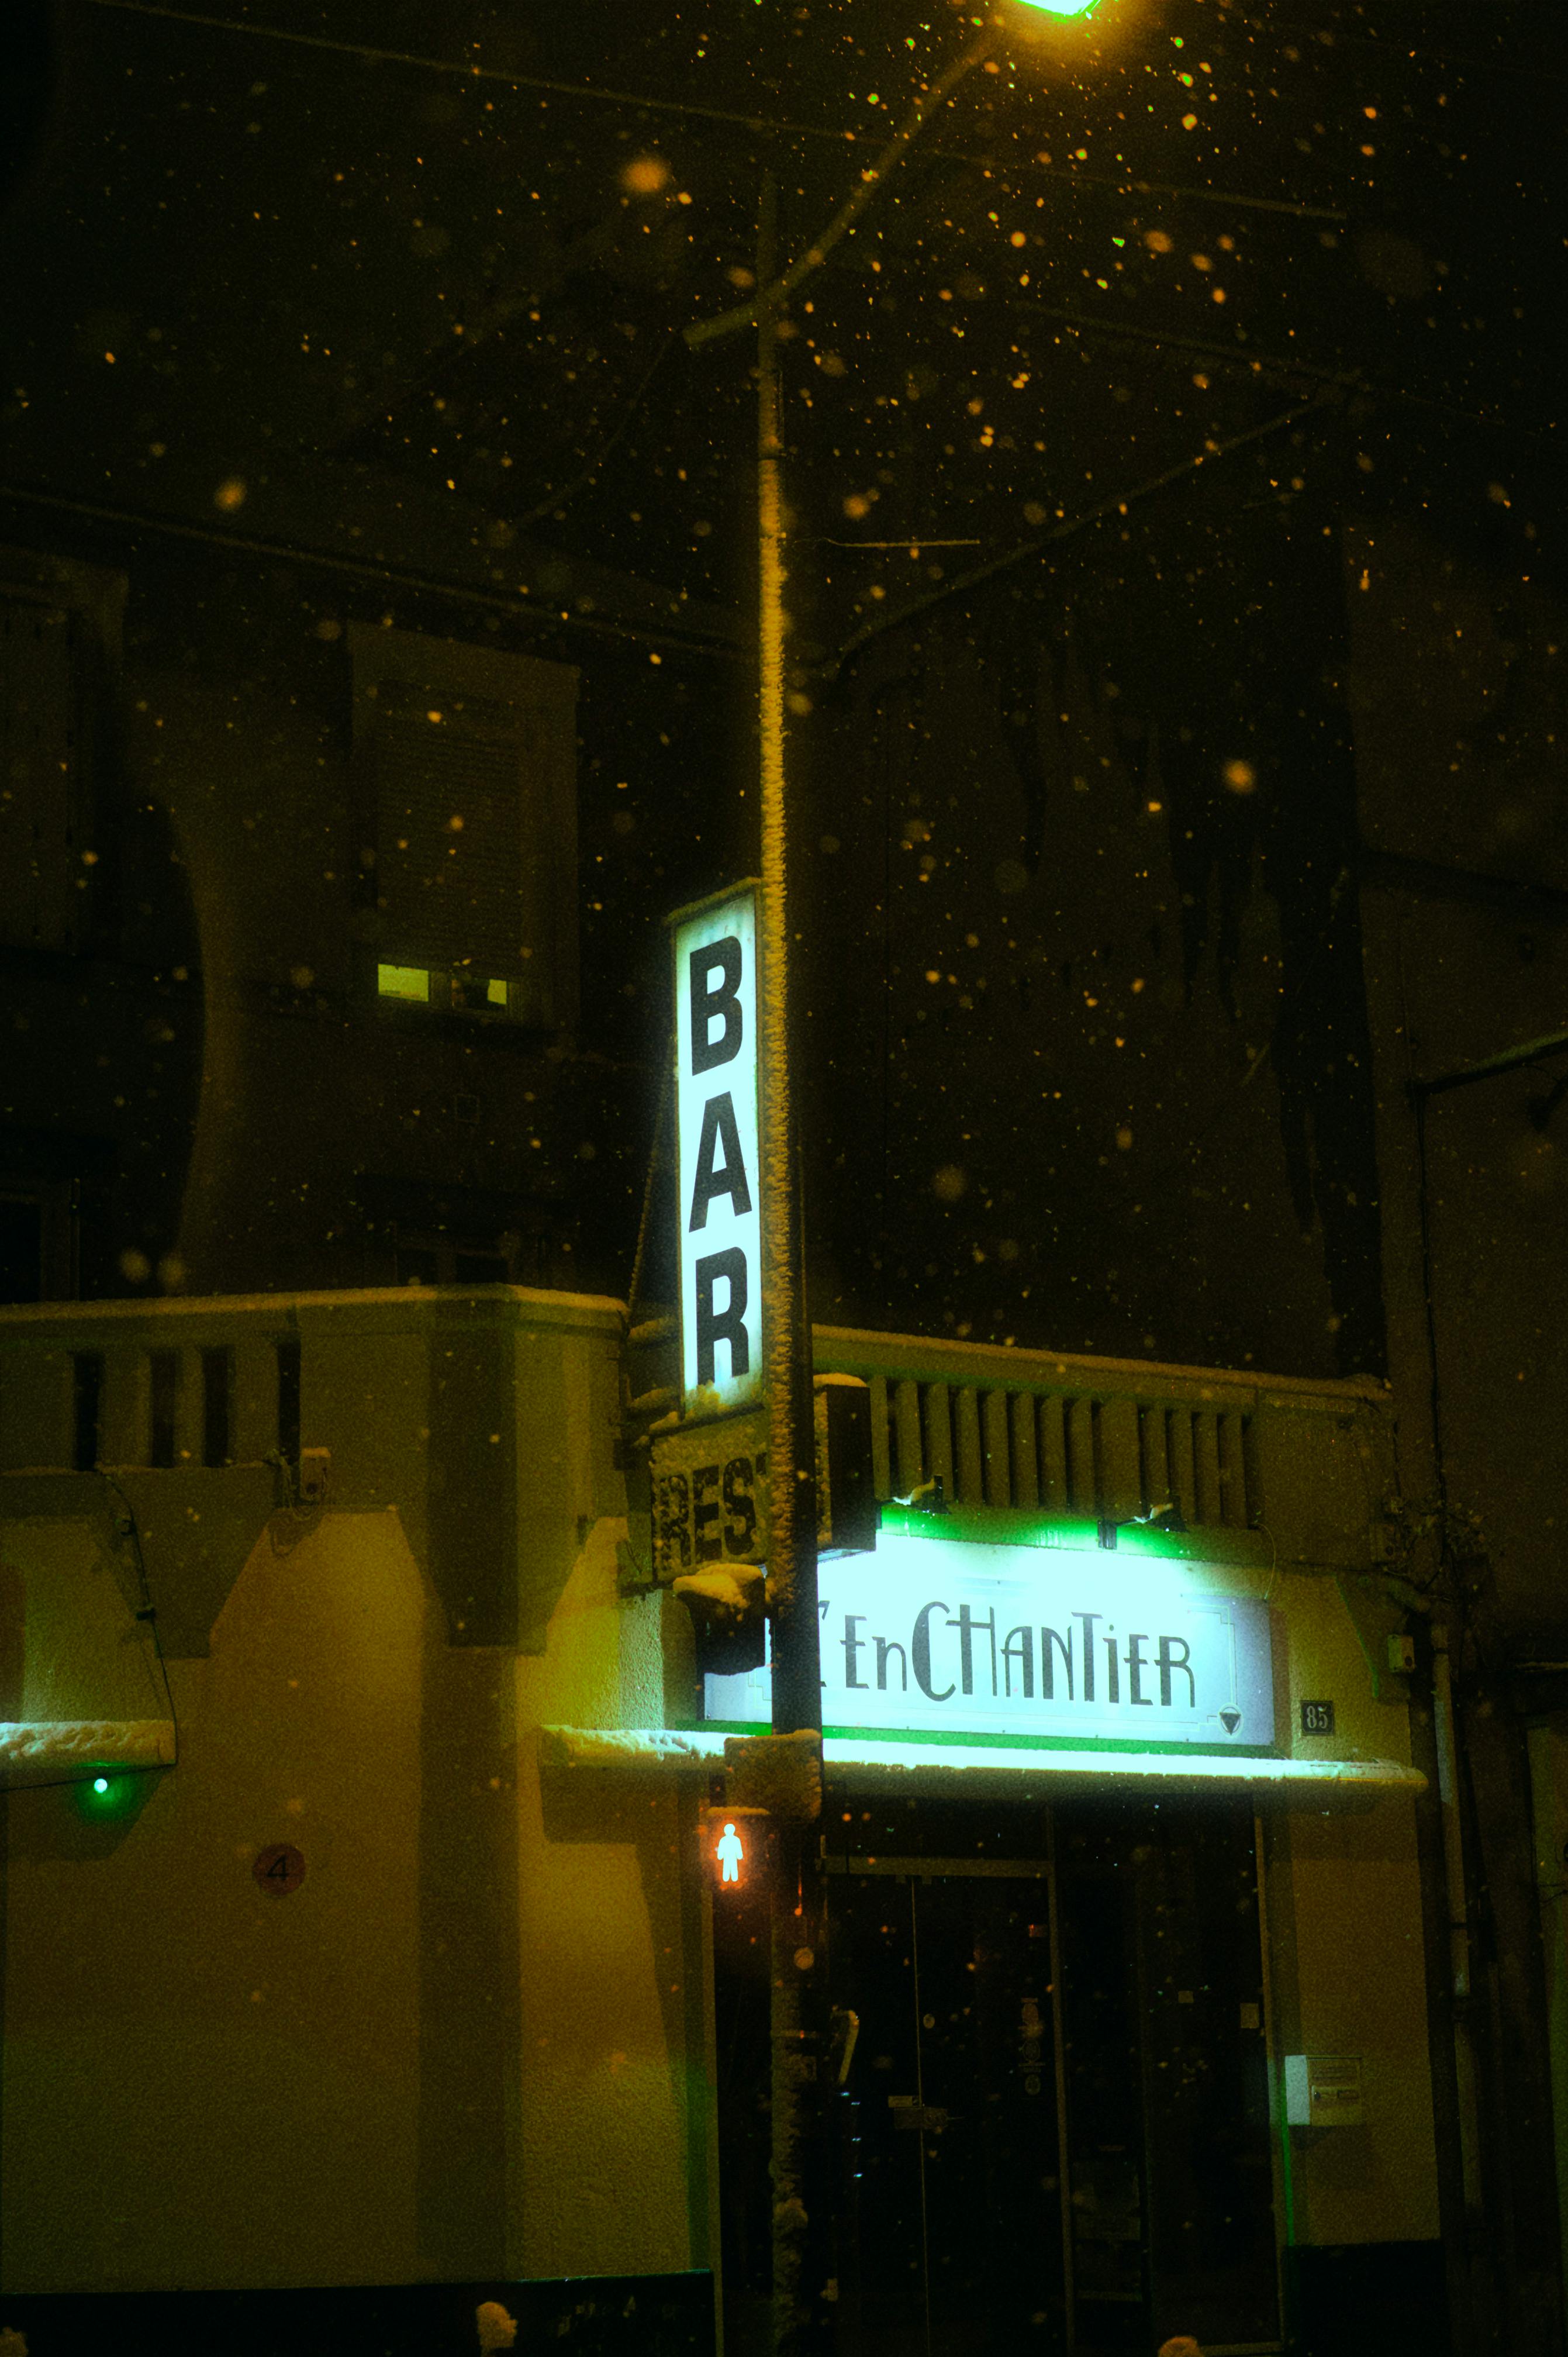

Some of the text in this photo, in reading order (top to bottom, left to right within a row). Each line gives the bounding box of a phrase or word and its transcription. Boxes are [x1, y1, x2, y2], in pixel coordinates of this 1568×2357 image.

[689, 936, 752, 1386] BAR
[1307, 1705, 1328, 1728] 85
[267, 1854, 289, 1880] 4
